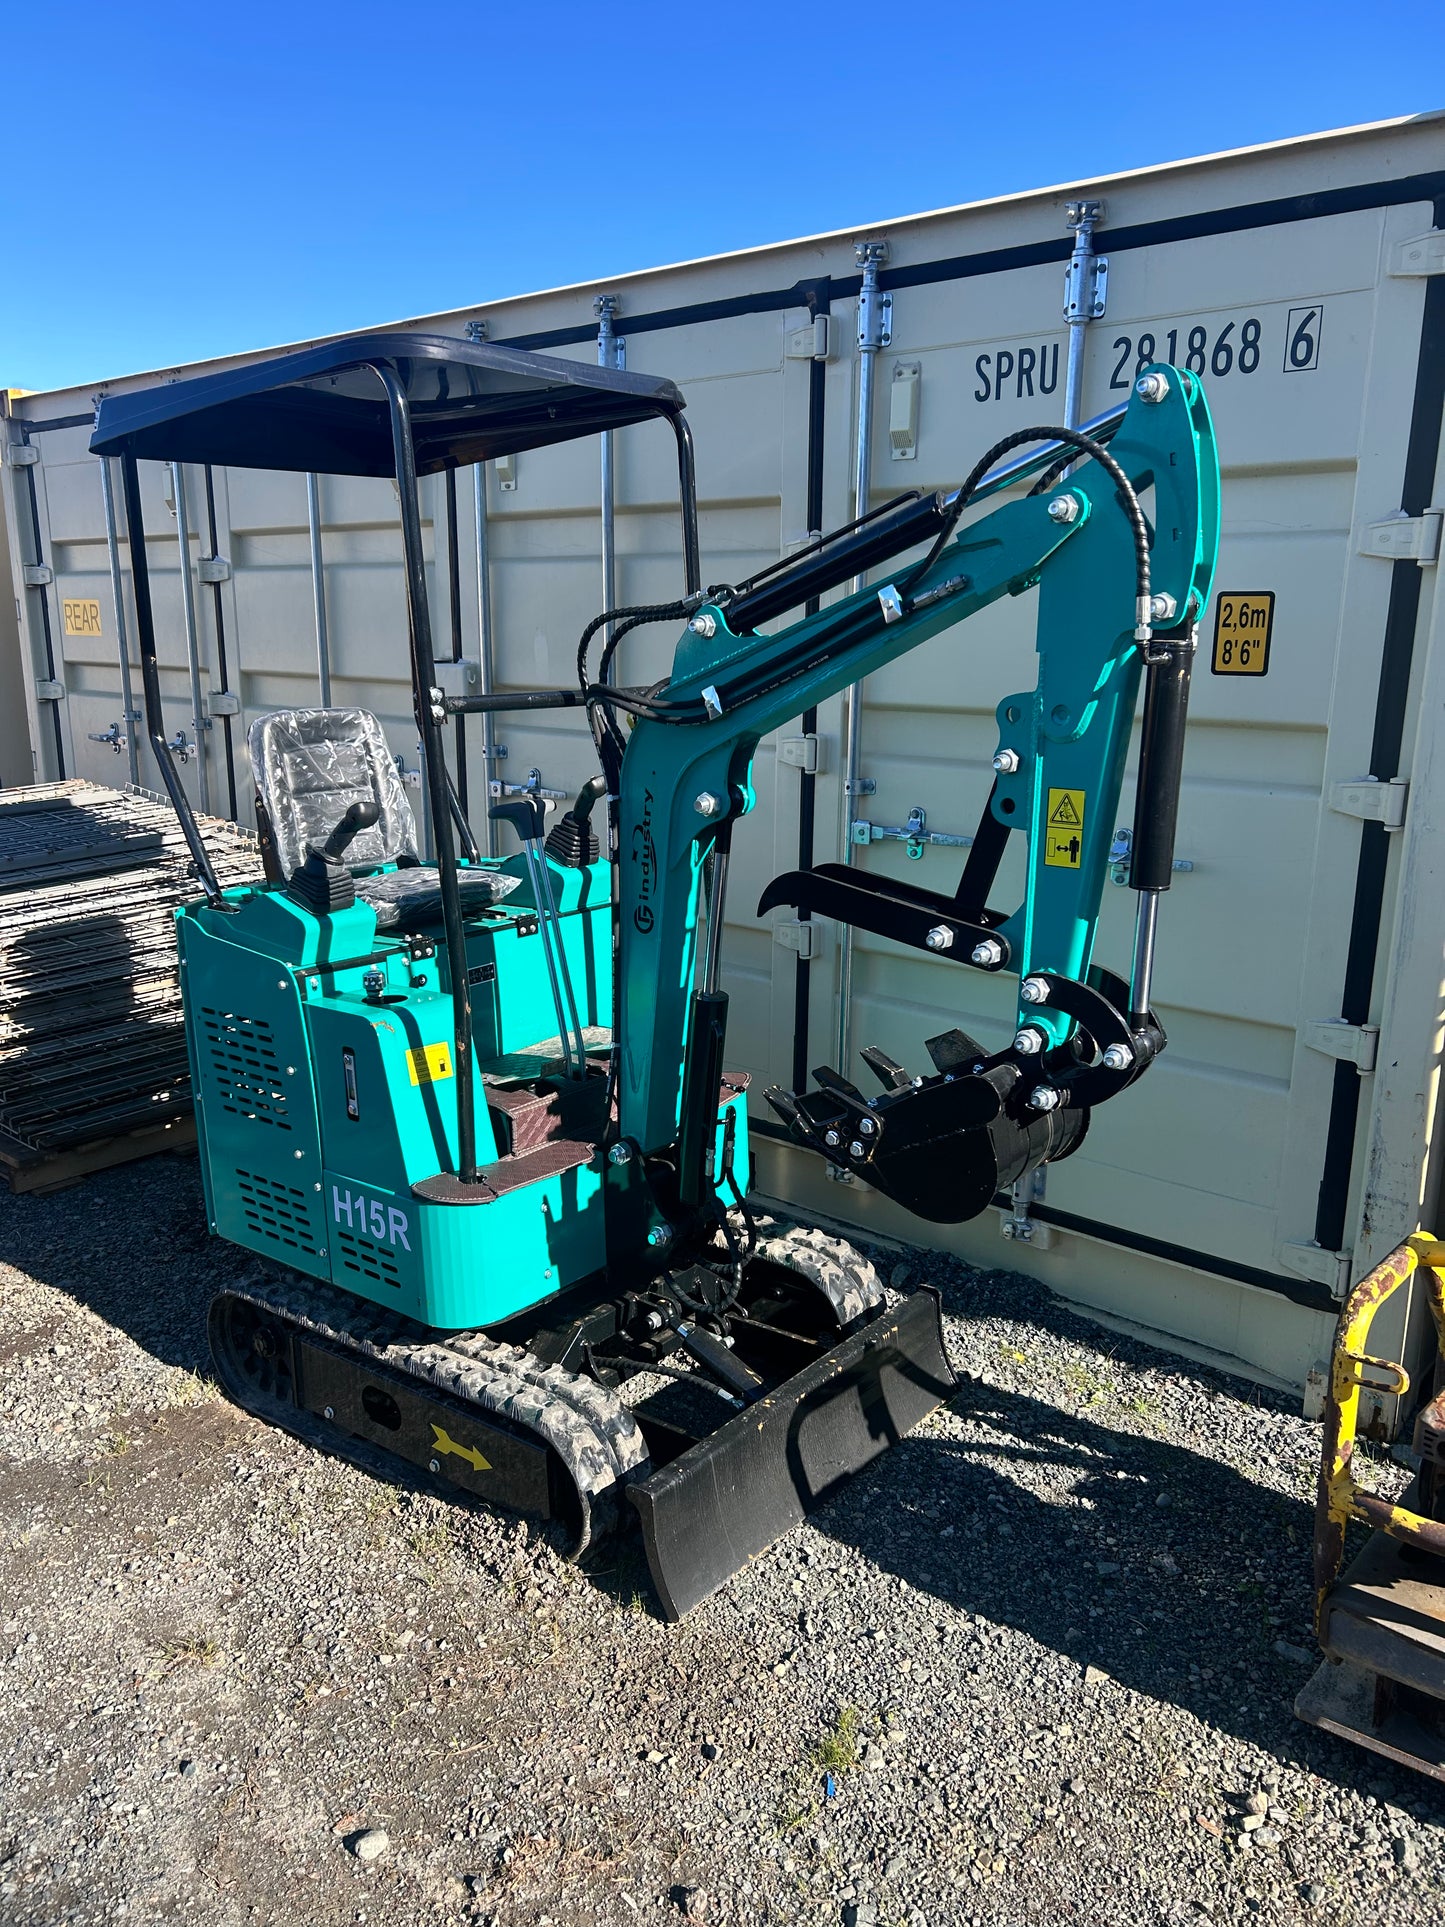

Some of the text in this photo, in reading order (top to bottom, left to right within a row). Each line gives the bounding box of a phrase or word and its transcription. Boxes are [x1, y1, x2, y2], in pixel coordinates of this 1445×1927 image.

[974, 343, 1059, 402] SPRU
[1290, 310, 1317, 368] 6
[64, 604, 101, 631] REAR
[1222, 602, 1266, 632] 2,6m
[1222, 640, 1260, 665] 8'6"
[332, 1185, 412, 1252] H15R
